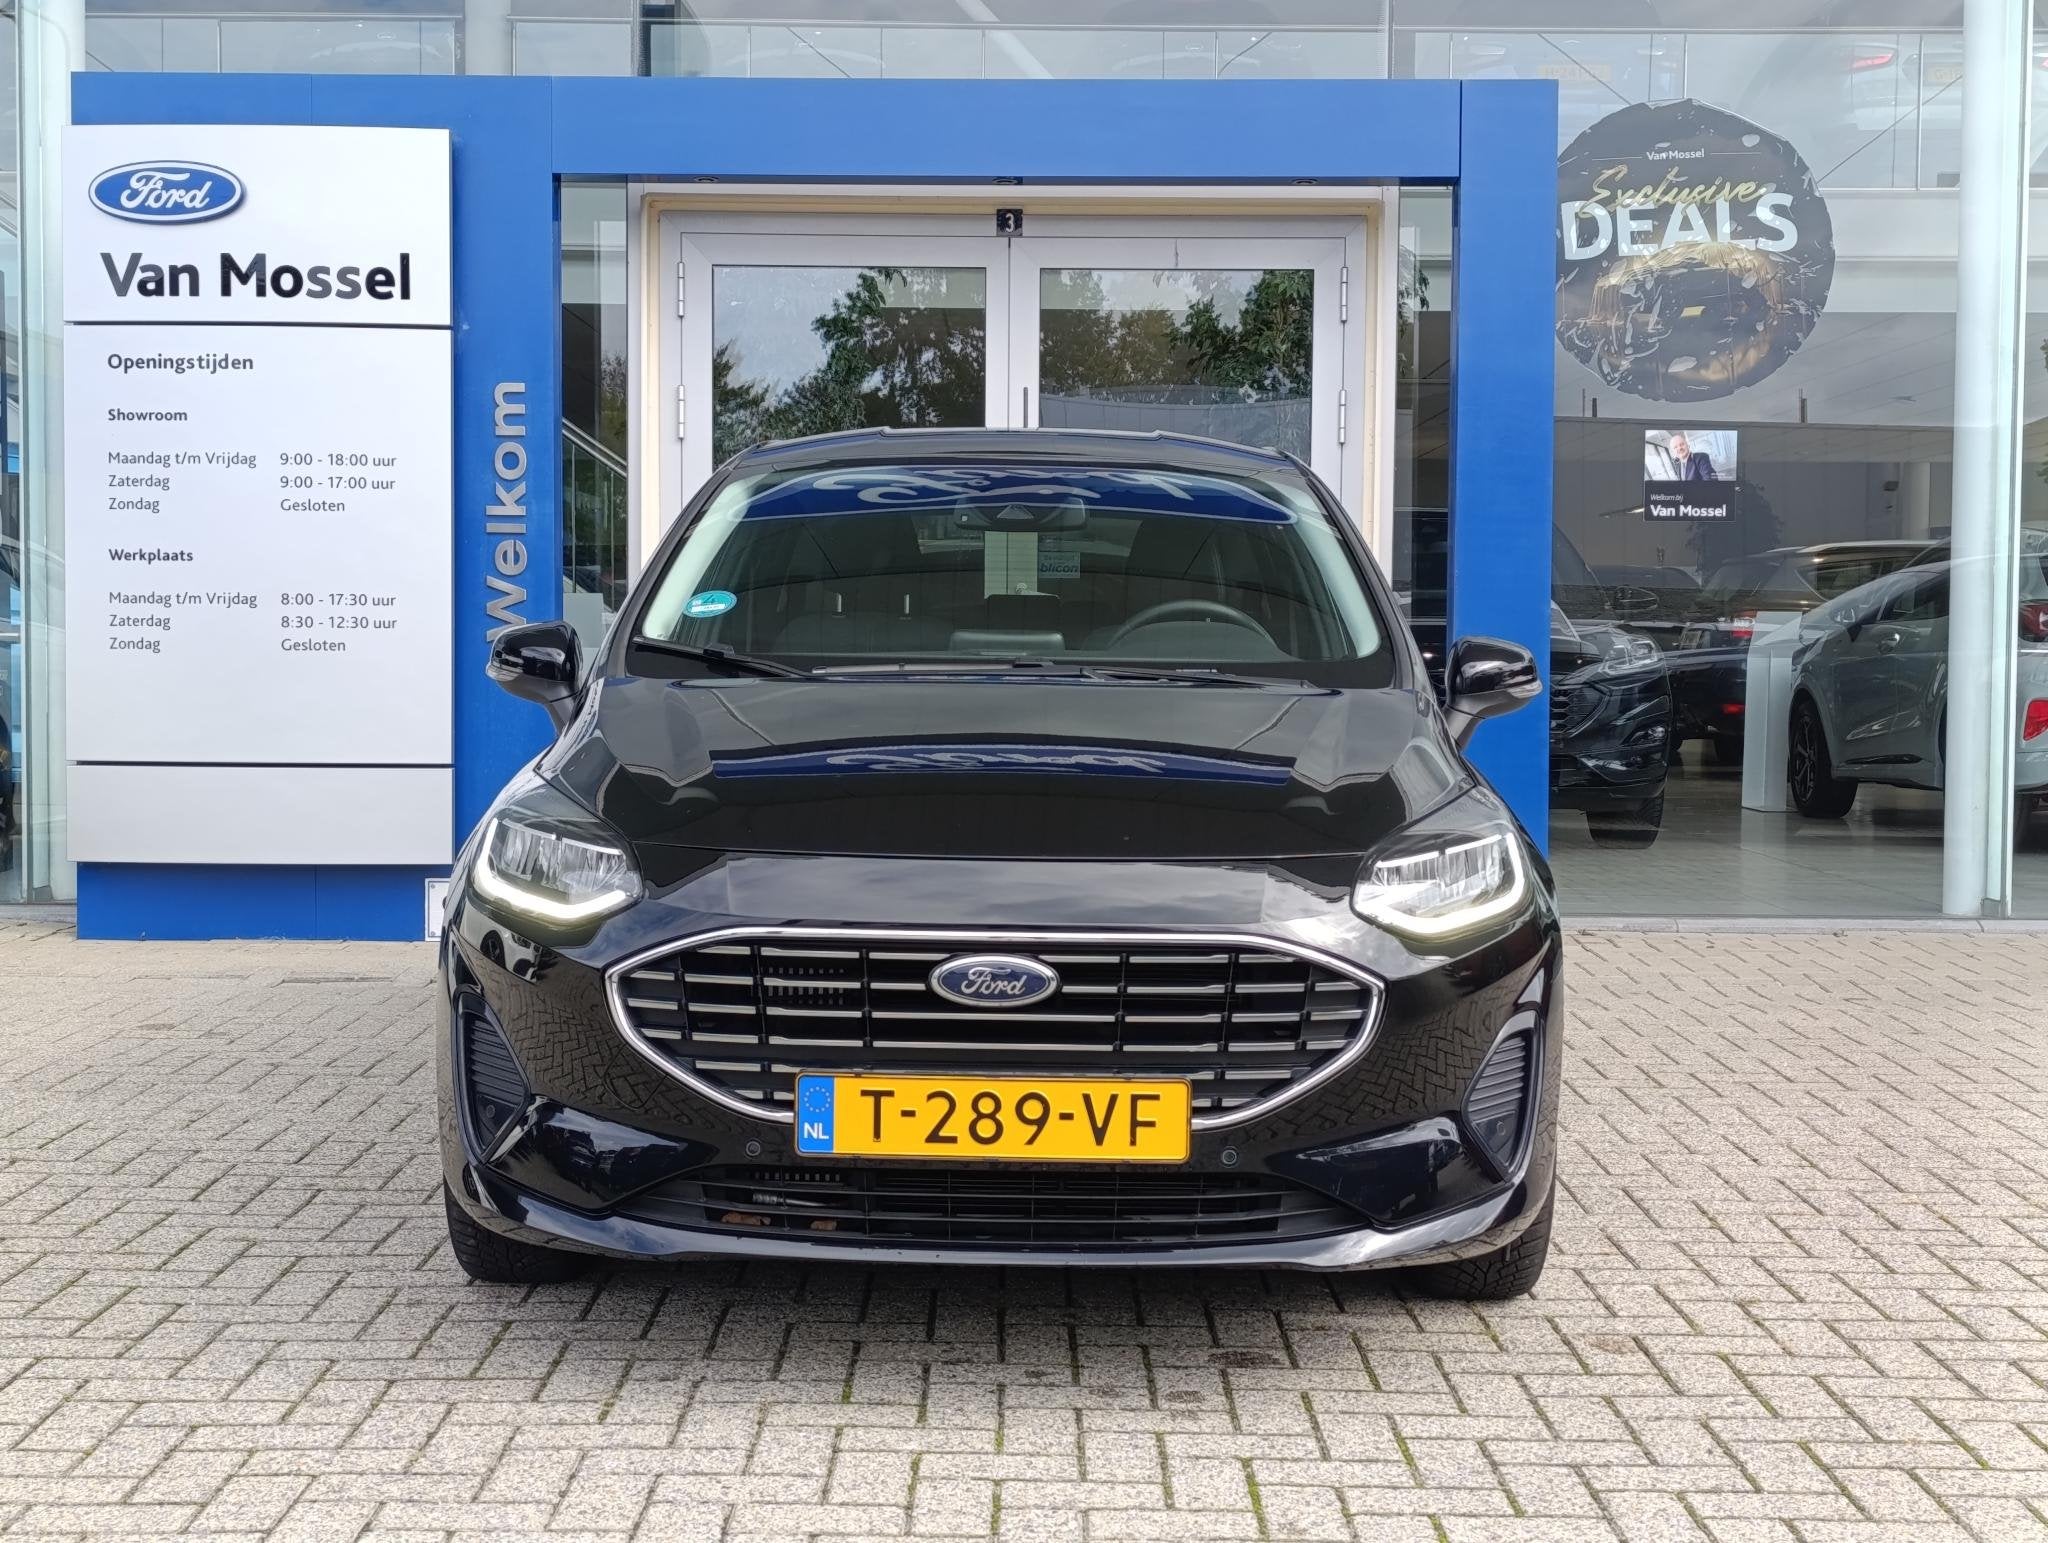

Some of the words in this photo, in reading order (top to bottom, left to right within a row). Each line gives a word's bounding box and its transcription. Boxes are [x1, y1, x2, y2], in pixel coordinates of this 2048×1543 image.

[1646, 150, 1667, 161] Van
[1668, 148, 1705, 160] Mossel
[120, 170, 213, 209] Ford
[1577, 164, 1767, 218] Exclusive
[1004, 212, 1015, 233] 3
[1560, 192, 1799, 261] DEALS
[100, 252, 200, 298] Van
[219, 252, 411, 301] Mossel
[107, 352, 254, 375] Openingstijden
[107, 407, 188, 422] Showroom
[108, 450, 172, 469] Maandag
[174, 451, 201, 465] t/m
[204, 451, 257, 469] Vrijdag
[279, 452, 313, 466] 9:00
[327, 453, 369, 467] 18:00
[372, 457, 397, 467] uur
[108, 473, 171, 492] Zaterdag
[279, 475, 314, 489] 9:00
[327, 476, 368, 490] 17:00
[371, 480, 396, 490] uur
[108, 496, 161, 514] Zondag
[280, 498, 346, 512] Gesloten
[484, 382, 528, 642] Welkom
[1650, 504, 1676, 517] Van
[1679, 504, 1727, 517] Mossel
[108, 547, 194, 565] Werkplaats
[109, 591, 172, 609] Maandag
[175, 591, 202, 605] t/m
[205, 591, 258, 609] Vrijdag
[280, 592, 314, 606] 8:00
[328, 593, 369, 607] 17:30
[372, 596, 397, 607] uur
[108, 613, 171, 631] Zaterdag
[280, 615, 314, 629] 8:30
[328, 615, 369, 629] 12:30
[373, 619, 398, 630] uur
[109, 636, 161, 654] Zondag
[280, 637, 347, 652] Gesloten
[961, 967, 1027, 994] Ford
[860, 1088, 1161, 1147] T-289-VF
[803, 1122, 830, 1140] NL
